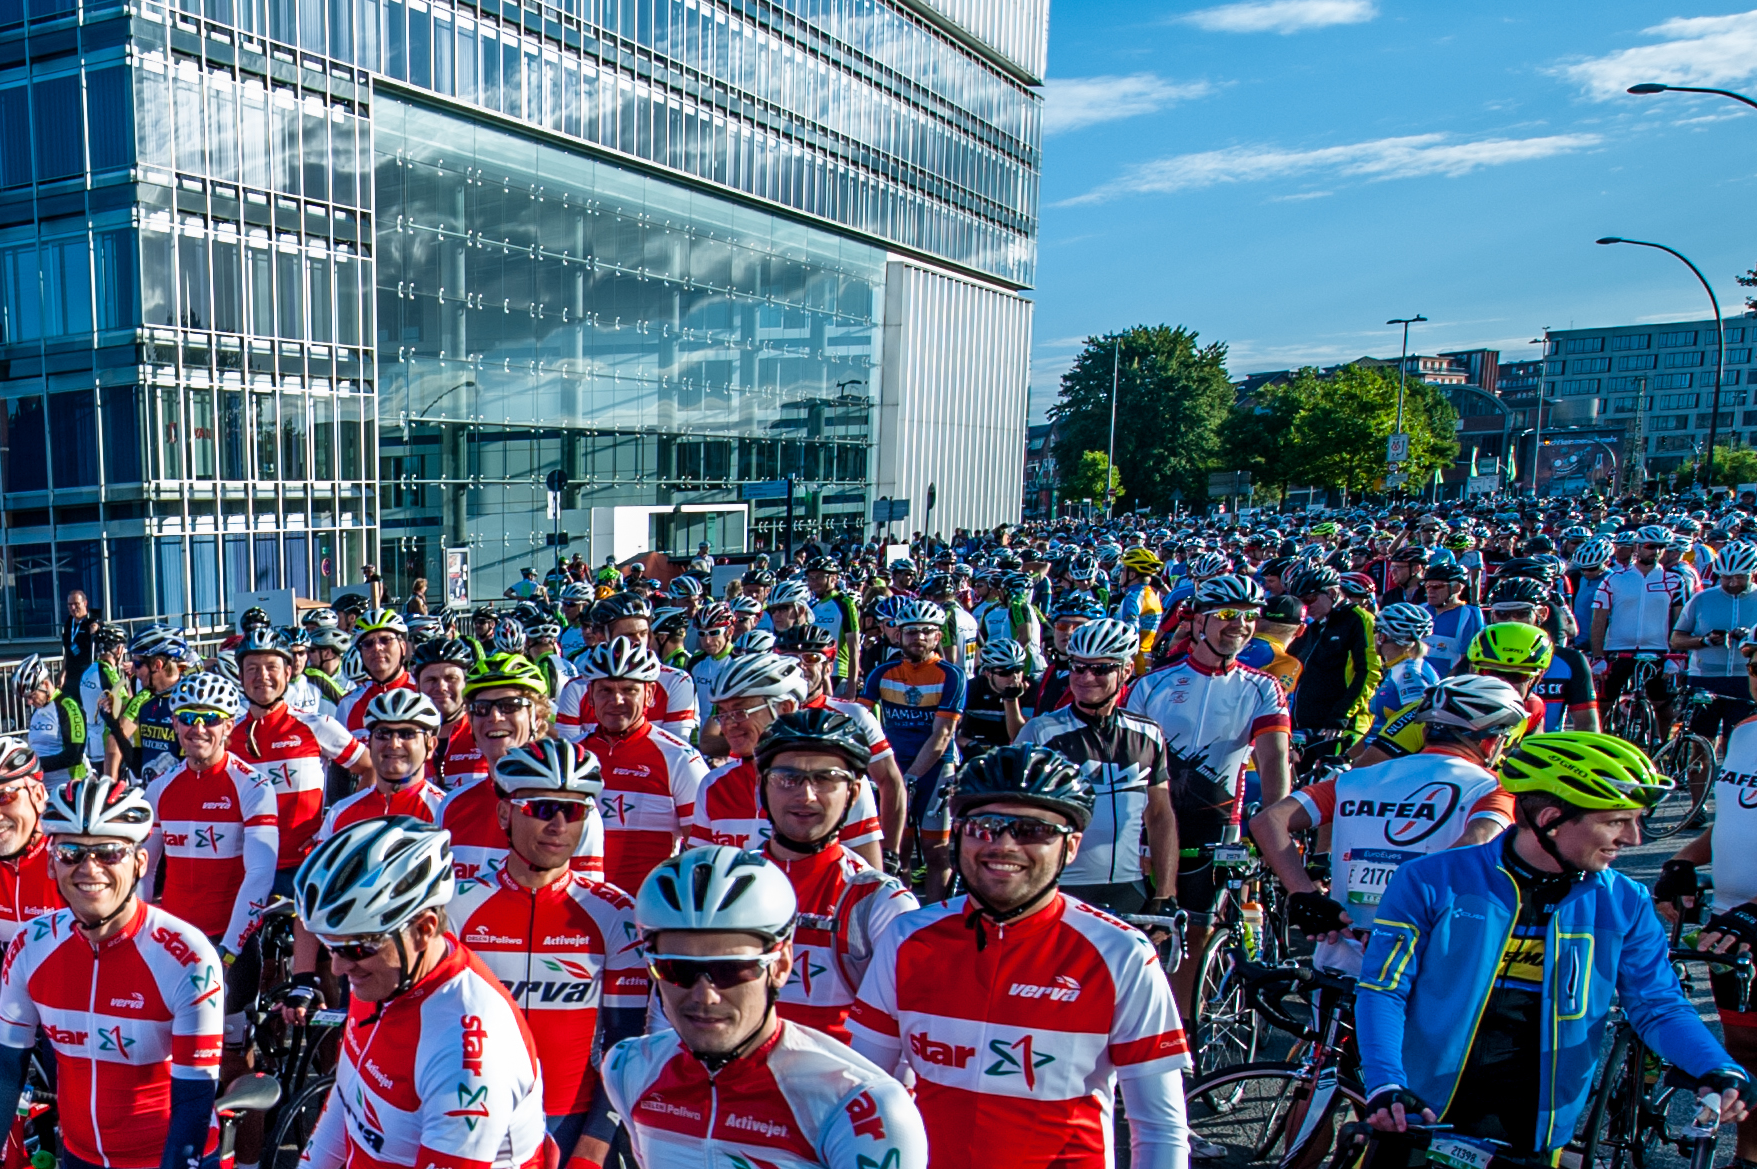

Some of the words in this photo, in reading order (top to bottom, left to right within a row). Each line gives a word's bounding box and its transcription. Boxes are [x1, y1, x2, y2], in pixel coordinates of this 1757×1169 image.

[1560, 758, 1588, 779] GIRO
[1339, 799, 1436, 821] CAFEA
[163, 831, 189, 847] tar
[713, 830, 750, 848] tar
[453, 859, 481, 880] tar
[151, 926, 202, 968] star
[489, 935, 523, 945] Paliwa
[543, 935, 590, 947] Activejet
[2, 928, 29, 986] star
[1008, 982, 1081, 1002] verva
[460, 1013, 489, 1078] star
[910, 1031, 976, 1070] star
[364, 1058, 393, 1090] Activejet
[666, 1104, 701, 1121] Paliwa
[724, 1112, 788, 1138] Activejet
[1450, 1145, 1478, 1164] 21398
